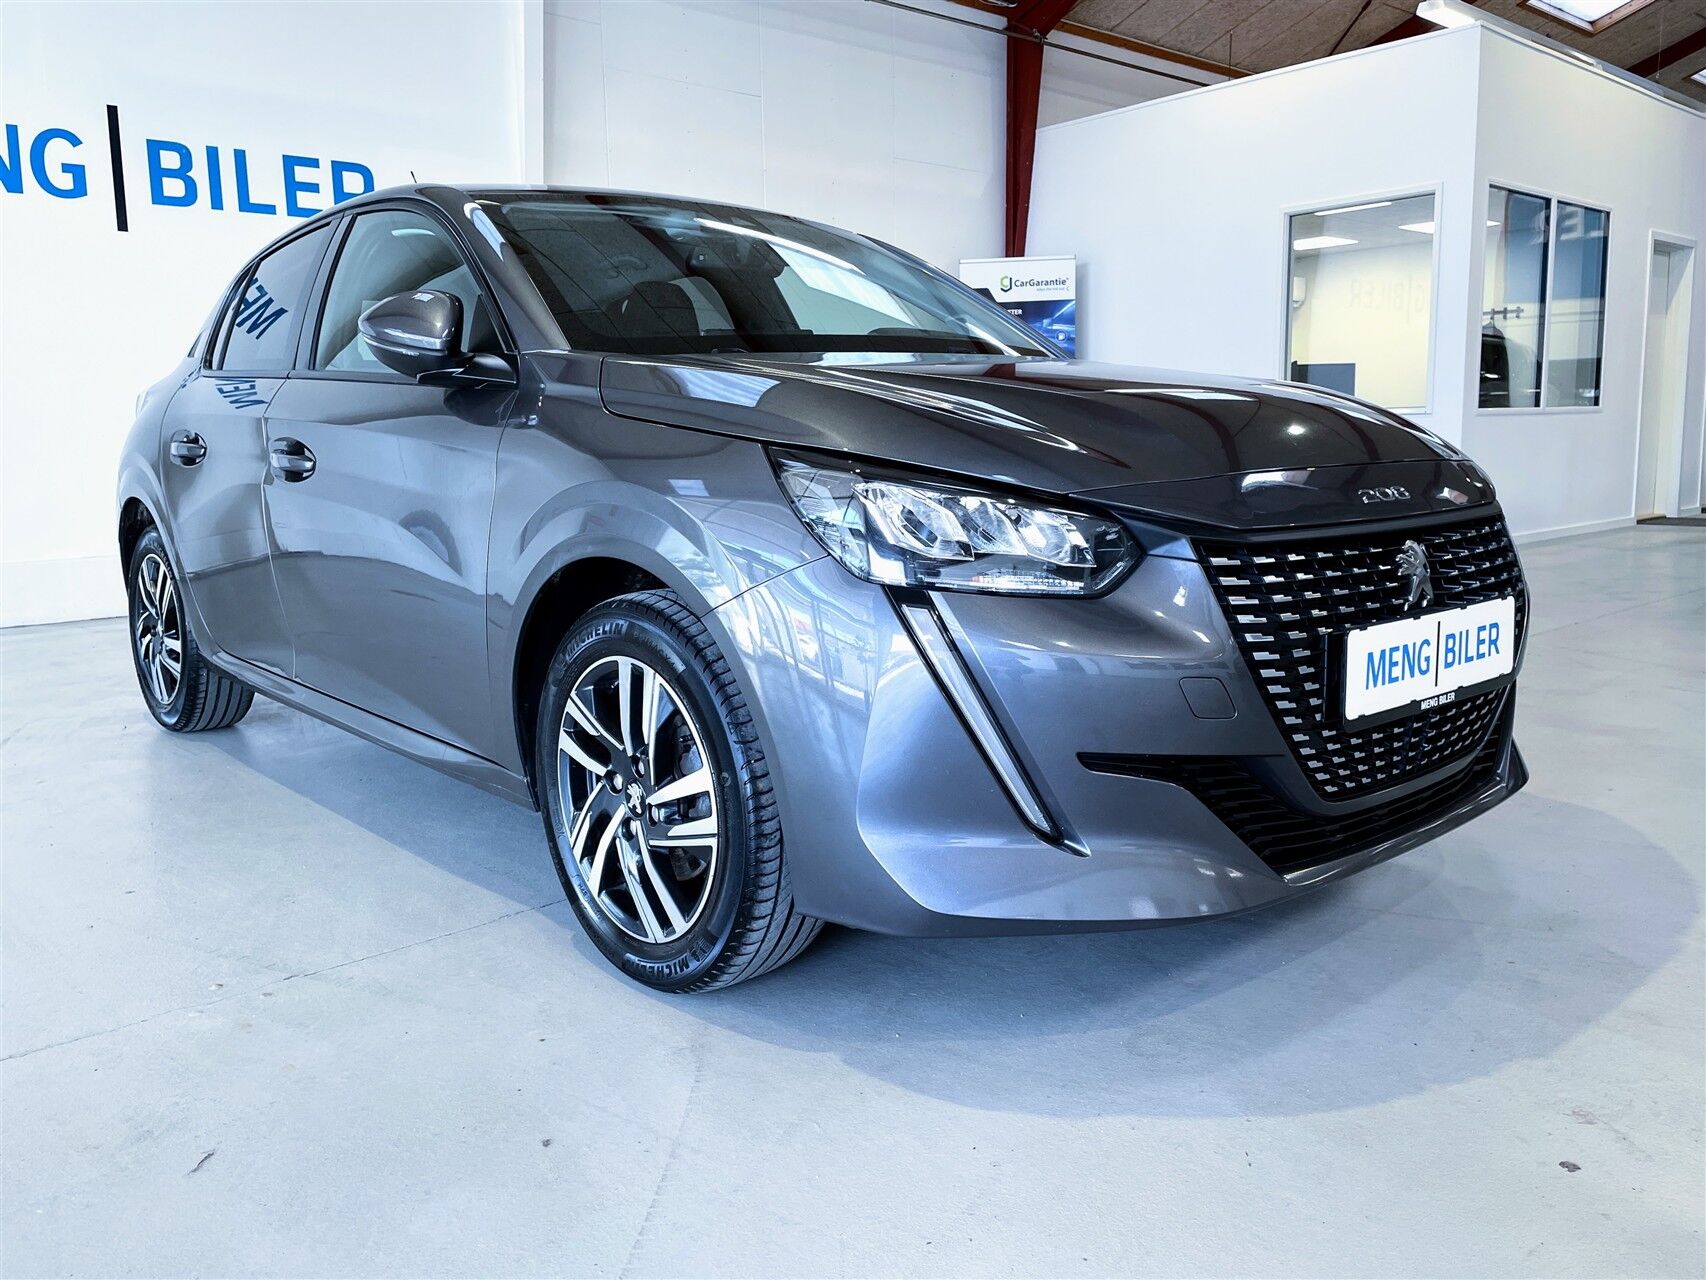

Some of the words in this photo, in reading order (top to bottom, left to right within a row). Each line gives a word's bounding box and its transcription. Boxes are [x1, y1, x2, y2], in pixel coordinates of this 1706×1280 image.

[1358, 485, 1411, 504] 208
[566, 620, 628, 658] MICHELIN
[1365, 638, 1431, 690] MENG
[1443, 622, 1501, 670] BILER
[1421, 697, 1438, 710] MENG
[1439, 691, 1456, 704] BILER
